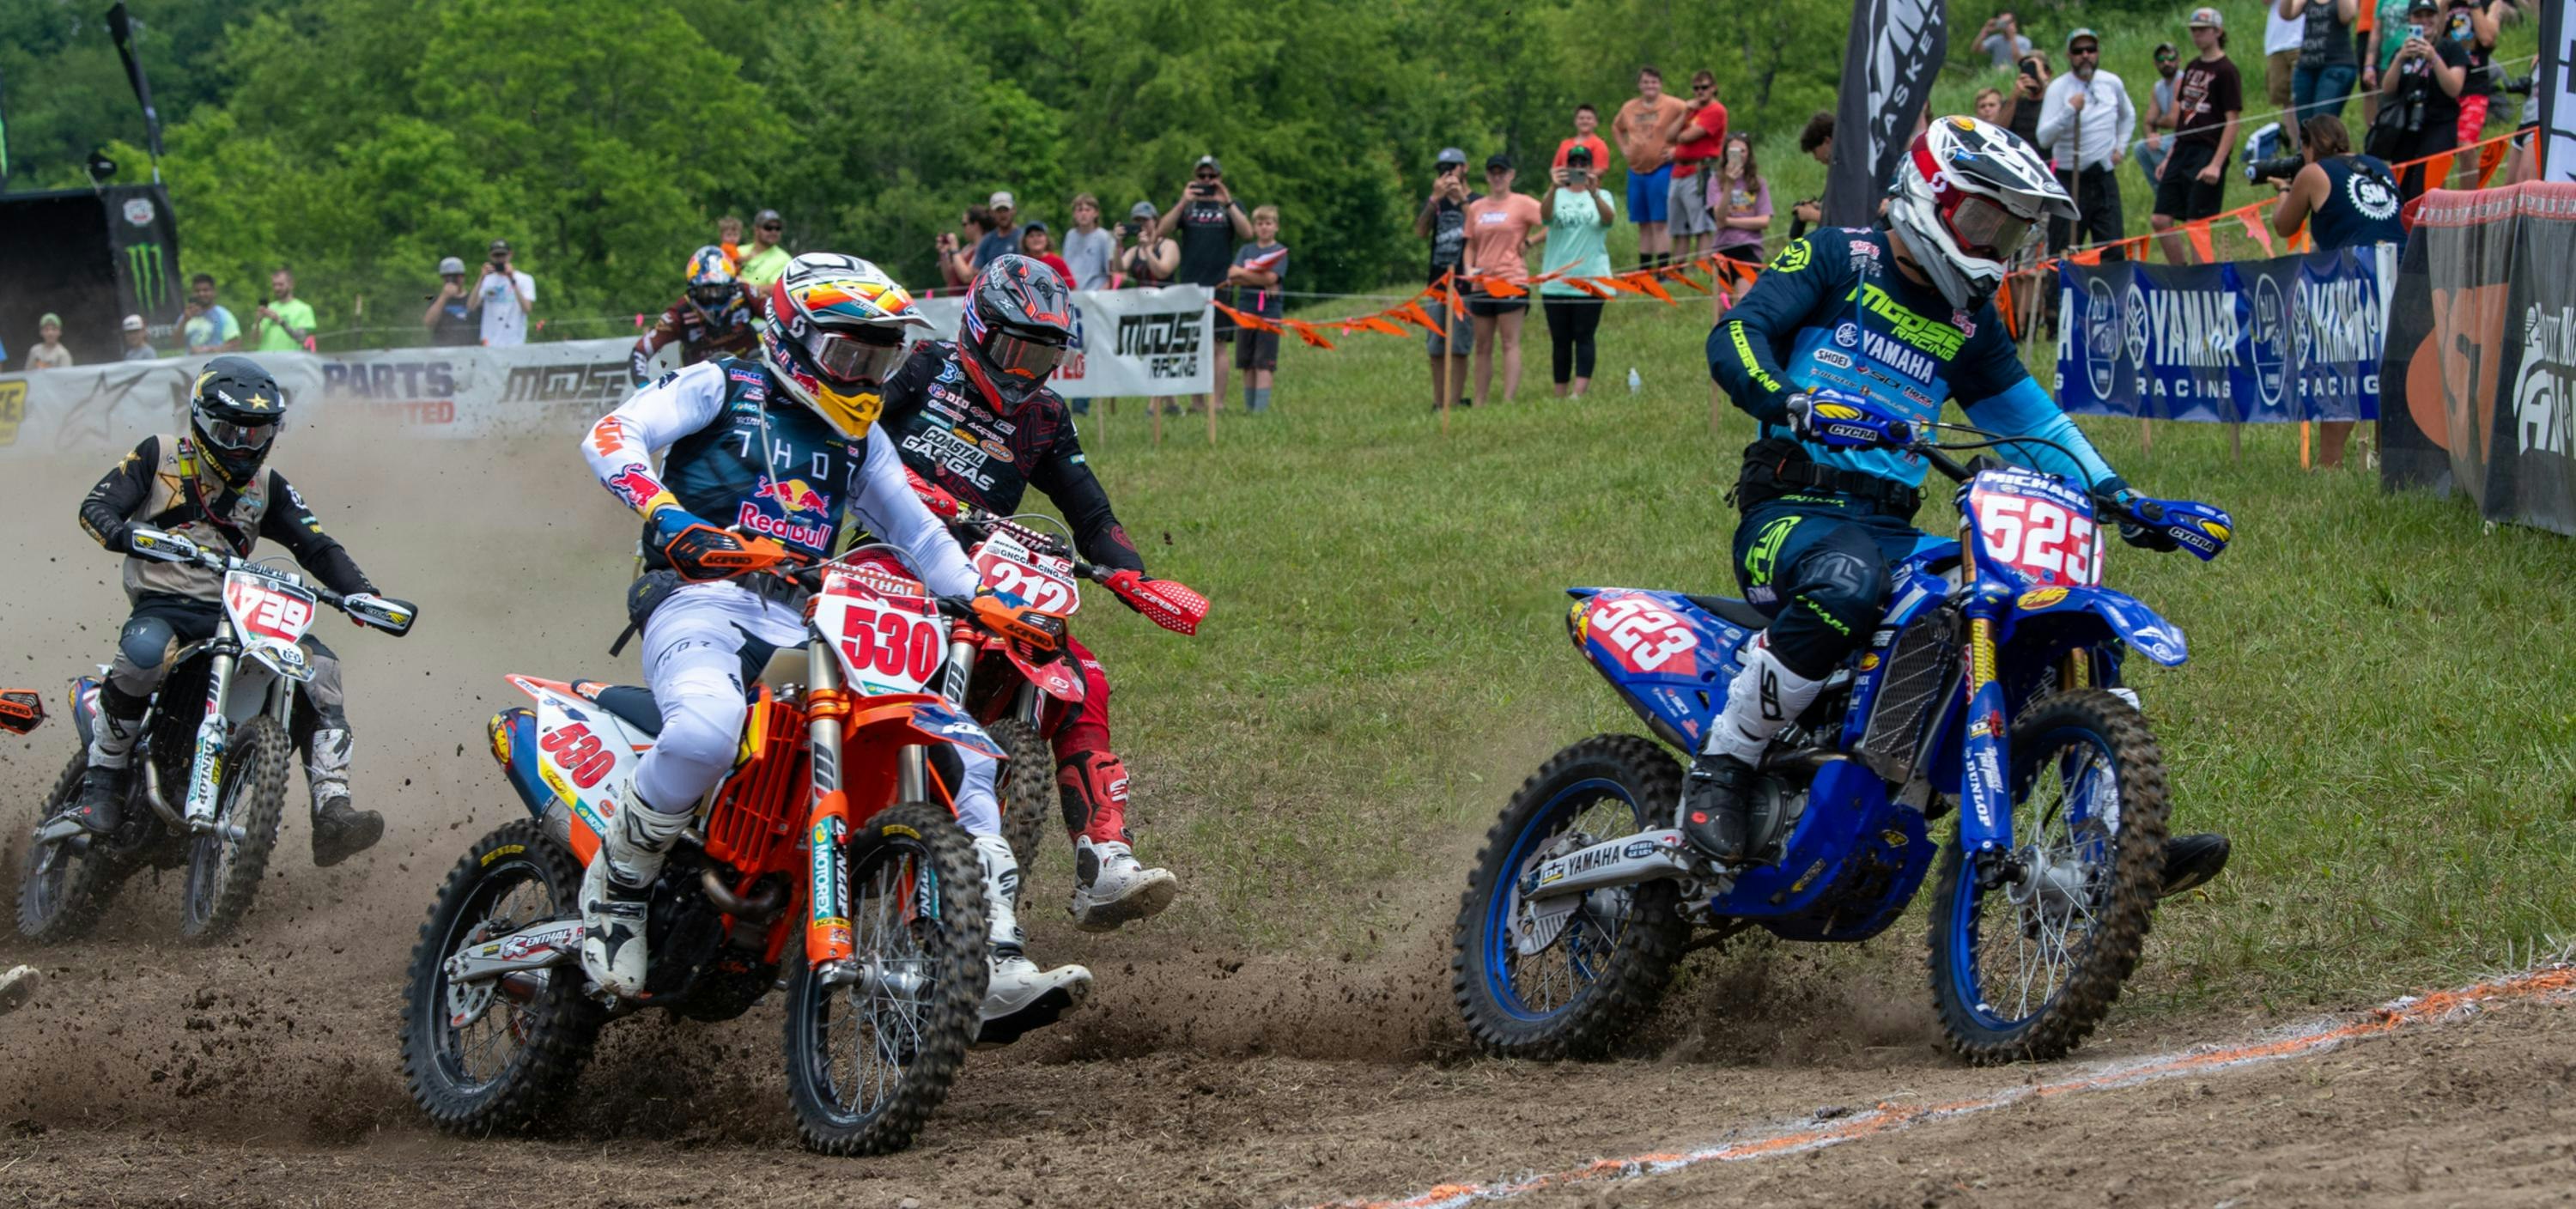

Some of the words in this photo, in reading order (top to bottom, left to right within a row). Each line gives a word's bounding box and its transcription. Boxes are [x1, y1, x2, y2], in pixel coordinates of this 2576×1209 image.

[1845, 282, 1966, 351] MOOSE
[1817, 349, 1849, 368] SHOEI
[1862, 329, 1935, 384] YAMAHA
[1892, 325, 1956, 362] RACING
[321, 361, 453, 399] PARTS
[2135, 379, 2232, 398] RACING
[2298, 374, 2379, 398] RACING
[922, 429, 984, 467] COASTAL
[1830, 424, 1878, 442] CYCRA
[902, 435, 996, 491] GASGAS
[1982, 472, 2091, 509] MICHAEL
[739, 501, 789, 536] Red
[789, 515, 833, 551] Bull
[1980, 495, 2104, 586] 523
[2169, 526, 2216, 553] CYCRA
[234, 587, 307, 636] 739
[991, 562, 1068, 614] 212
[841, 604, 939, 683] 530
[1591, 598, 1699, 672] 523
[197, 739, 216, 805] DUNLOP
[540, 722, 617, 789] 530
[1966, 760, 1992, 827] DUNLOP
[814, 843, 829, 917] MOTOREX
[835, 819, 849, 918] DNLOP
[1568, 845, 1620, 876] YAMAHA
